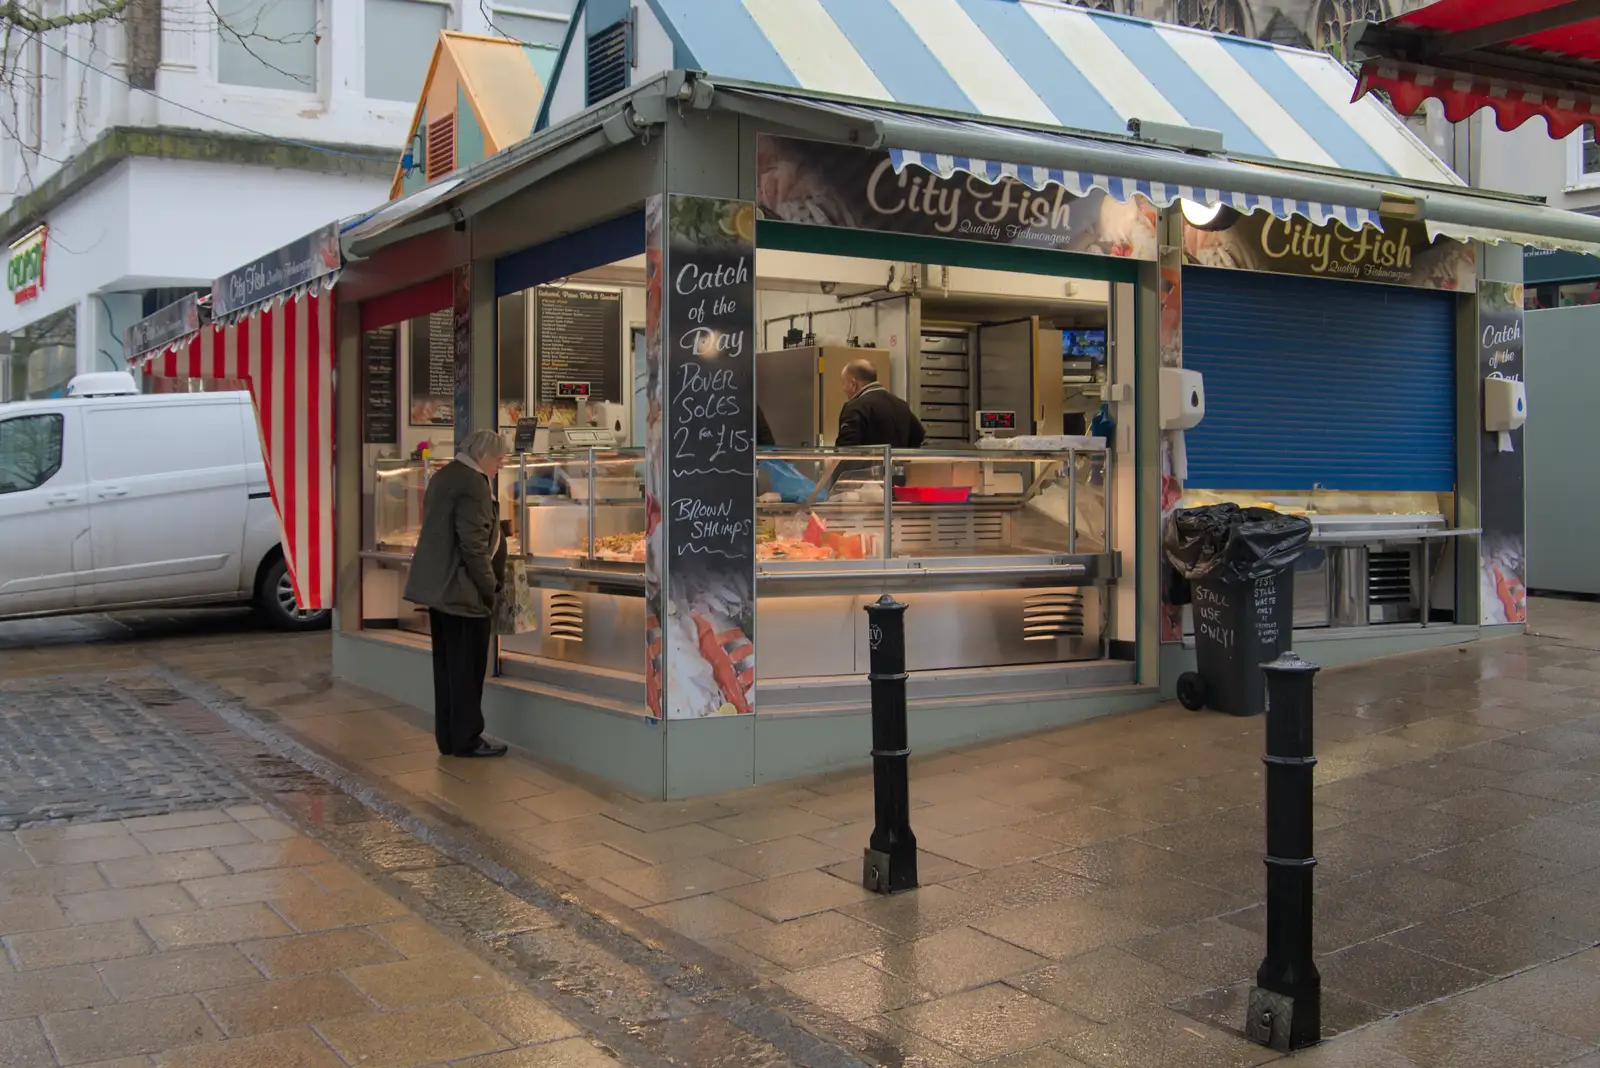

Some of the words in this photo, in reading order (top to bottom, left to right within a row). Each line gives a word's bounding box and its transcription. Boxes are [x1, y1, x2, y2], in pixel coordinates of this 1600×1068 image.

[866, 158, 961, 232] City
[966, 174, 1071, 230] Fish
[958, 218, 1001, 239] Quality
[1006, 223, 1071, 246] Fishmongers
[1261, 213, 1331, 272] City
[1334, 220, 1411, 268] Fish
[229, 273, 247, 304] City
[244, 262, 266, 295] Fish
[676, 256, 748, 296] Catch
[1328, 260, 1360, 278] Quality
[688, 299, 705, 323] of
[713, 296, 736, 316] the
[679, 326, 744, 357] Day
[1482, 320, 1521, 349] Catch
[1489, 351, 1499, 369] of
[1501, 349, 1514, 363] the
[679, 394, 740, 424] SOLES
[673, 427, 695, 458] 2
[671, 498, 732, 521] BROWN
[1196, 586, 1229, 607] STALL
[1200, 607, 1221, 623] USE
[1200, 624, 1234, 649] ONLY!
